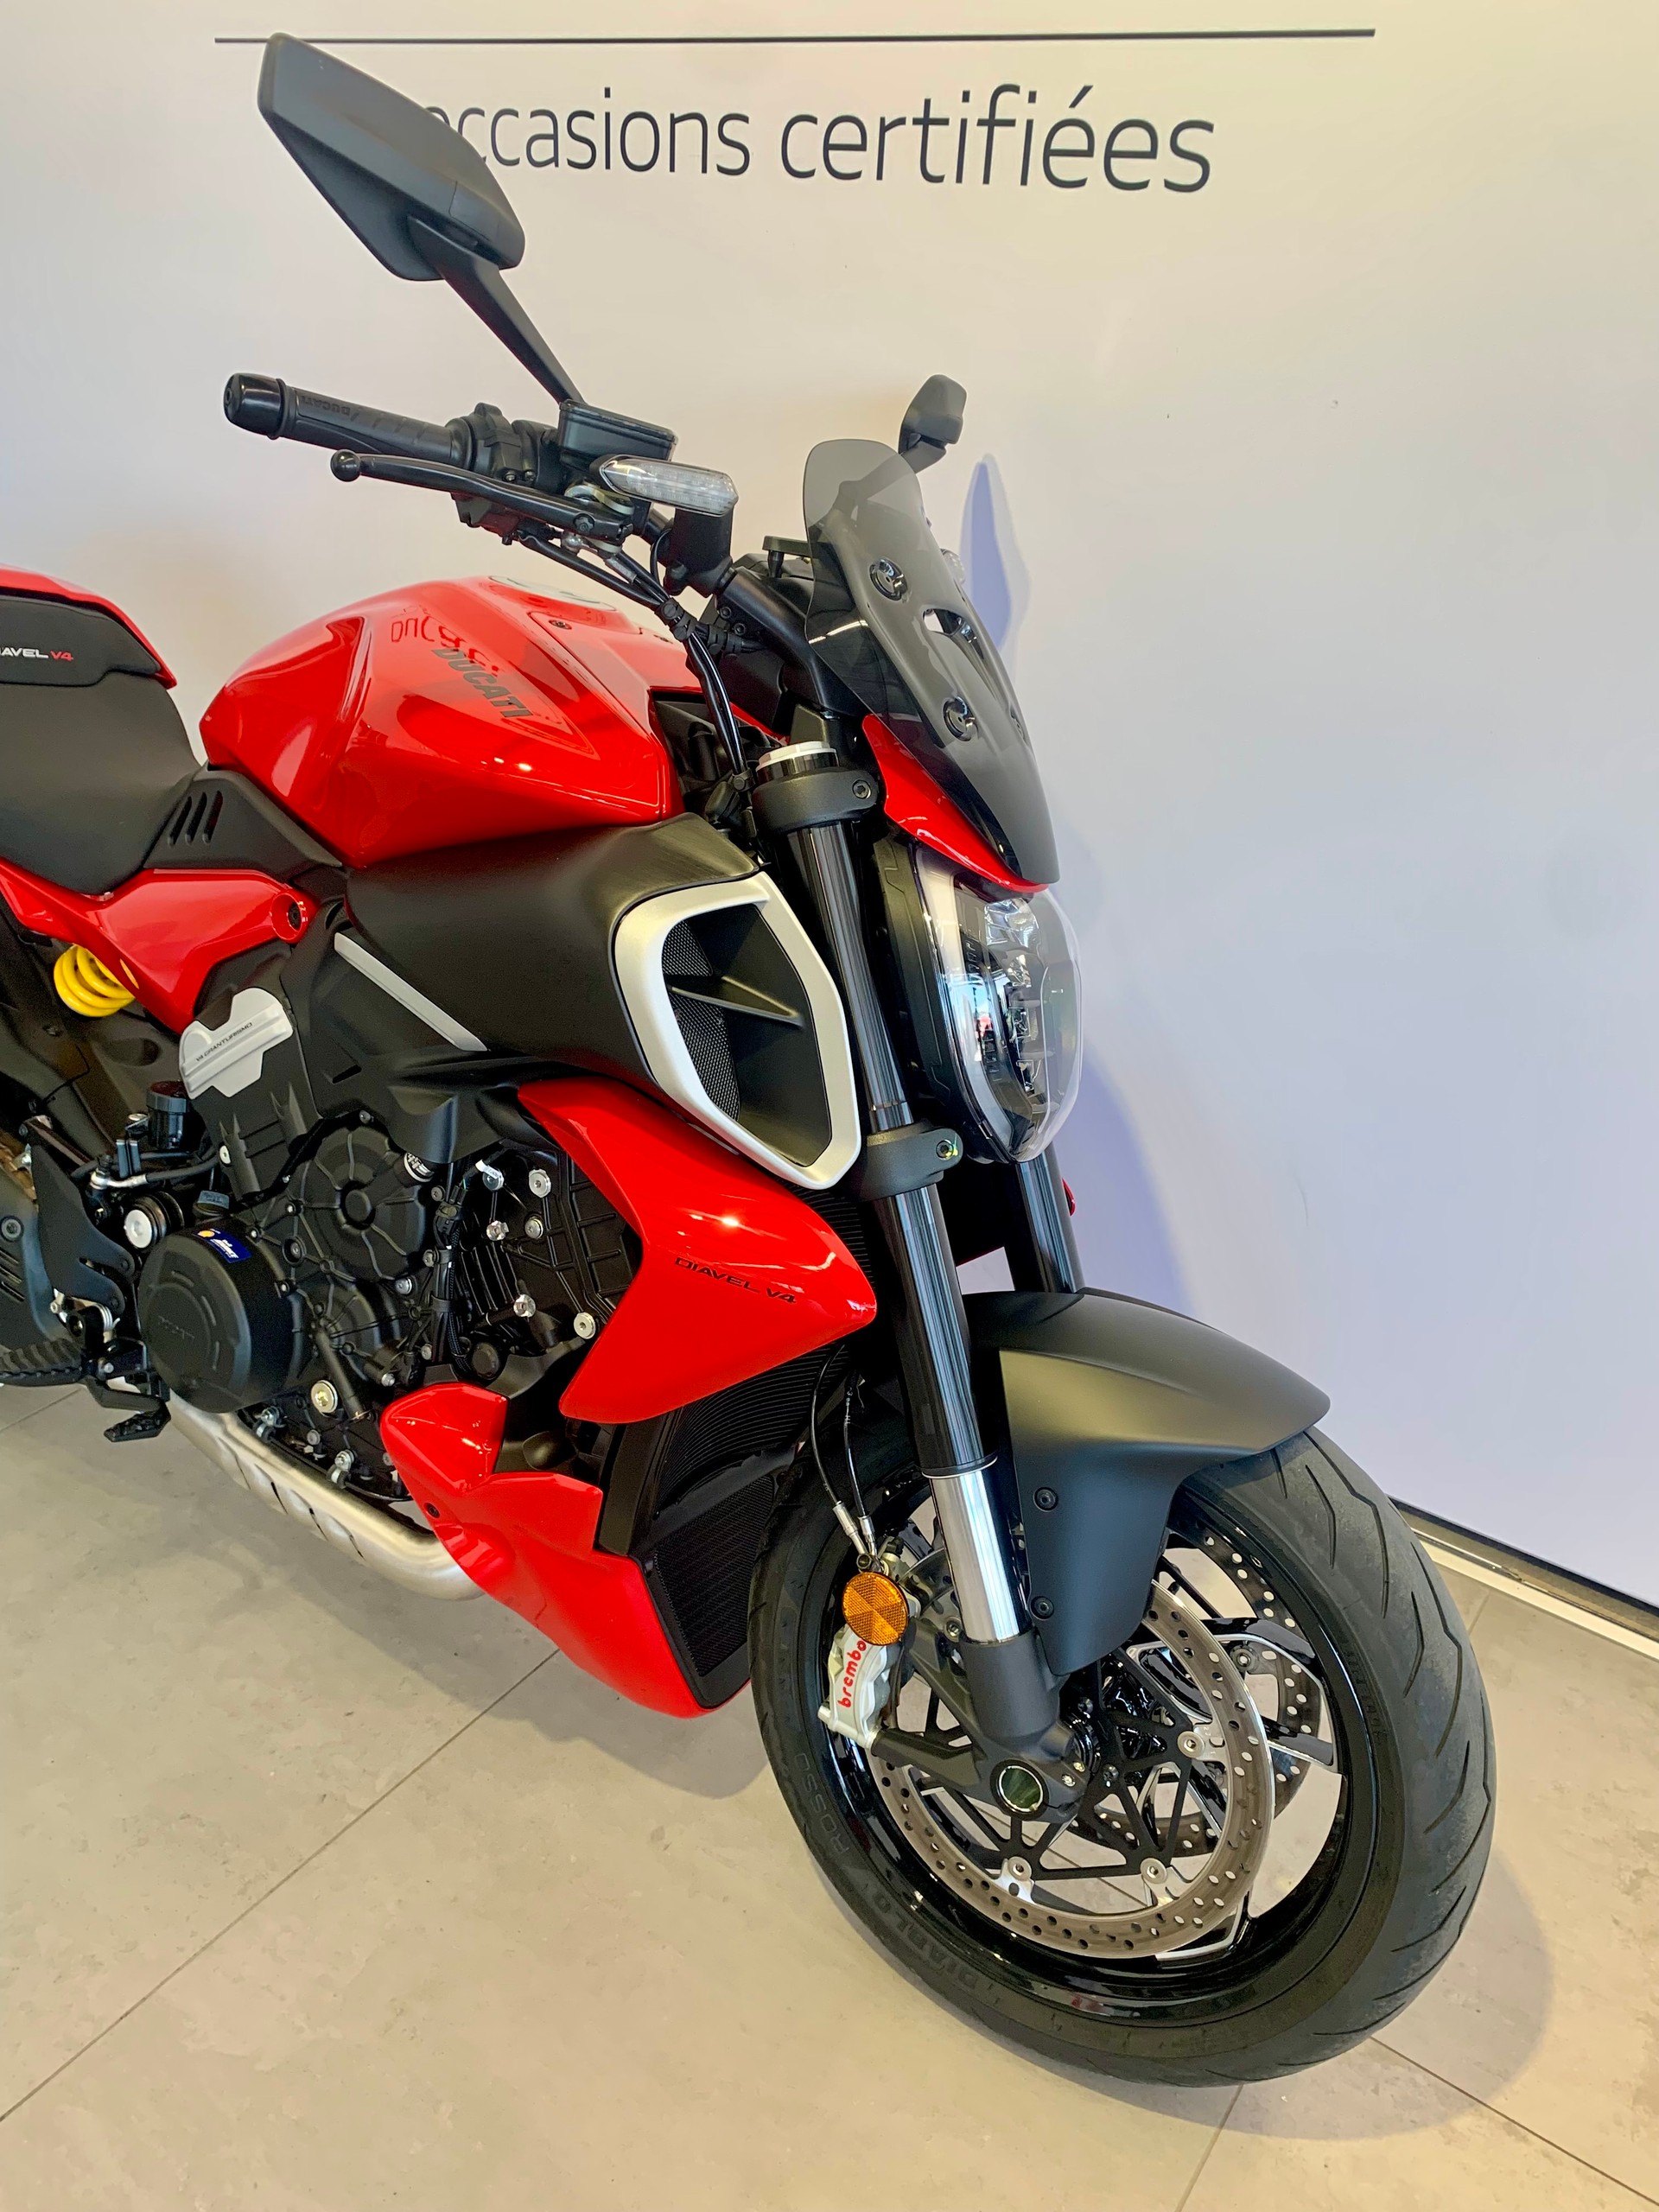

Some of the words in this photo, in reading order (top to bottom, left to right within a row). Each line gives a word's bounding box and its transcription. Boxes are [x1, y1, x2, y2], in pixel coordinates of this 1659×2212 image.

[424, 86, 751, 176] ccasions
[780, 83, 1215, 194] certifiées
[50, 650, 74, 662] V4
[431, 648, 534, 718] DUCATI
[204, 1021, 253, 1057] GRANTURISMO
[675, 1256, 761, 1294] DIAVEL
[766, 1287, 798, 1304] V4
[836, 1639, 868, 1708] brembo
[795, 1752, 850, 1853] ROSSO
